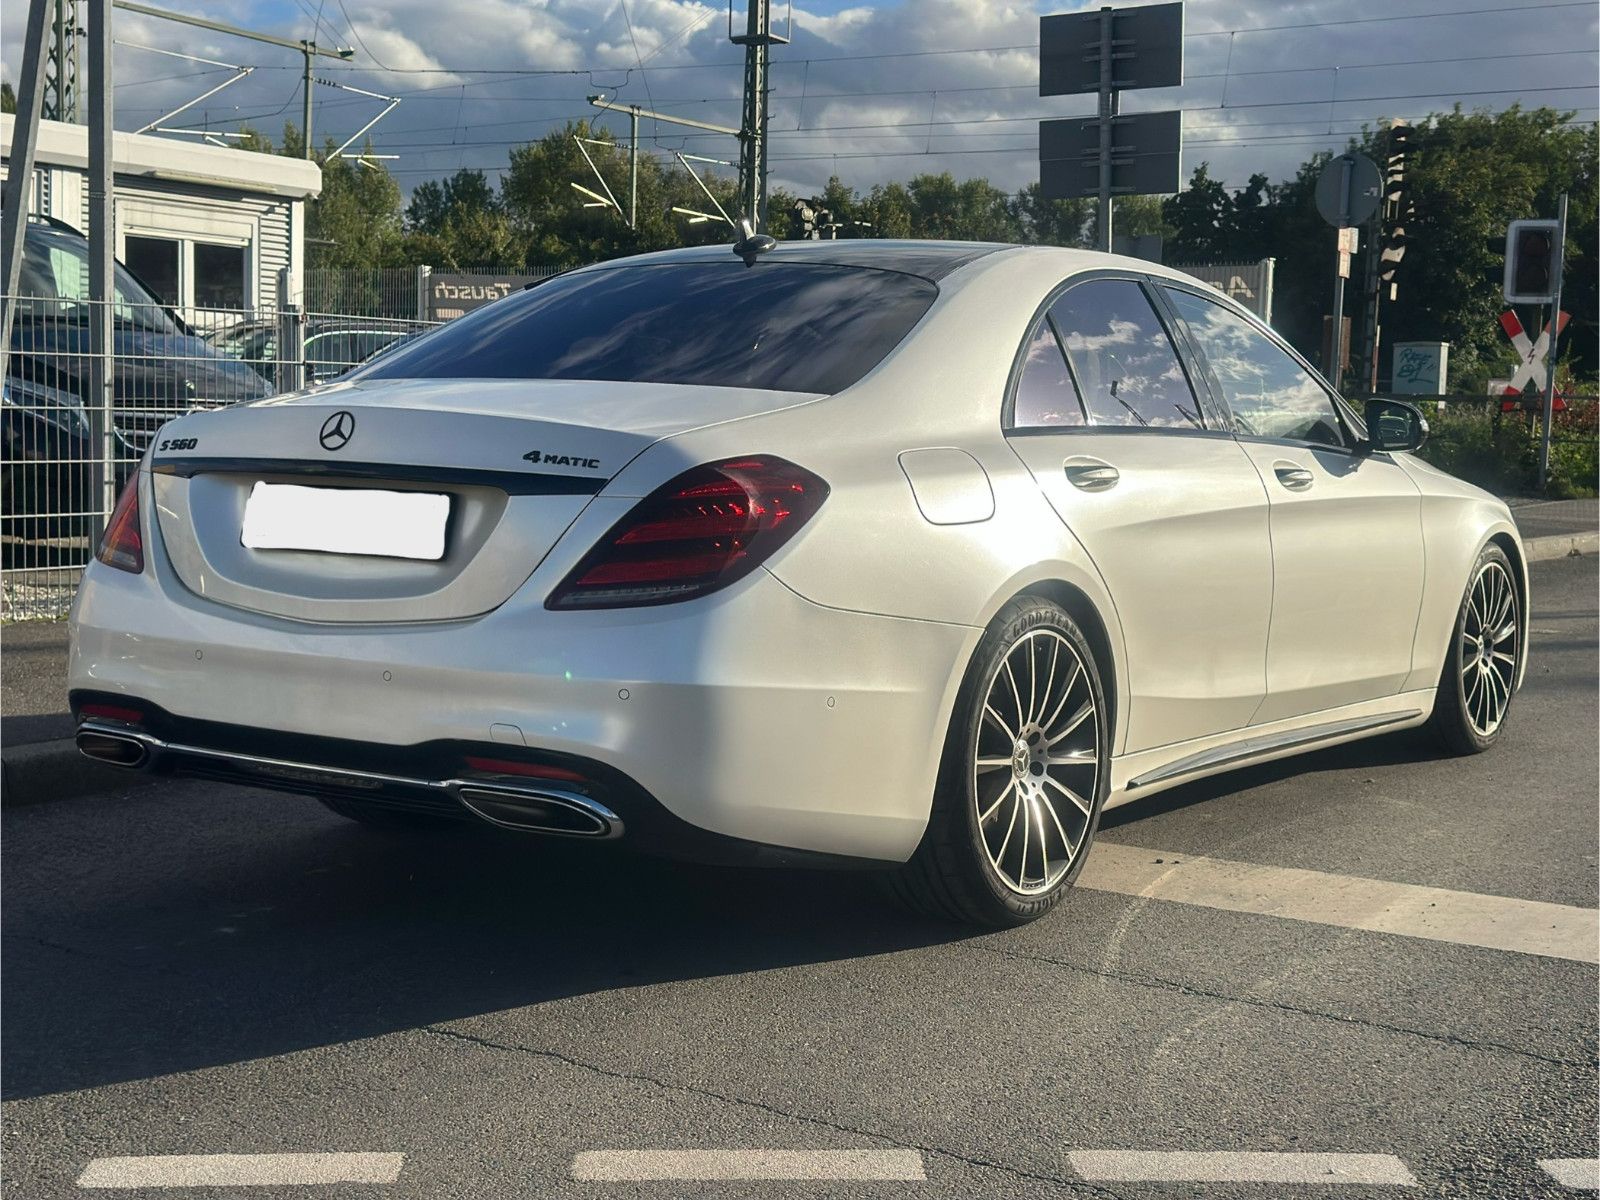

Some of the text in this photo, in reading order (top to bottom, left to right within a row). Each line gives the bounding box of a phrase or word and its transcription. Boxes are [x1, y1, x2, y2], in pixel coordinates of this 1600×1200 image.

[159, 438, 198, 451] S 560
[1013, 610, 1077, 638] GOODYEAR
